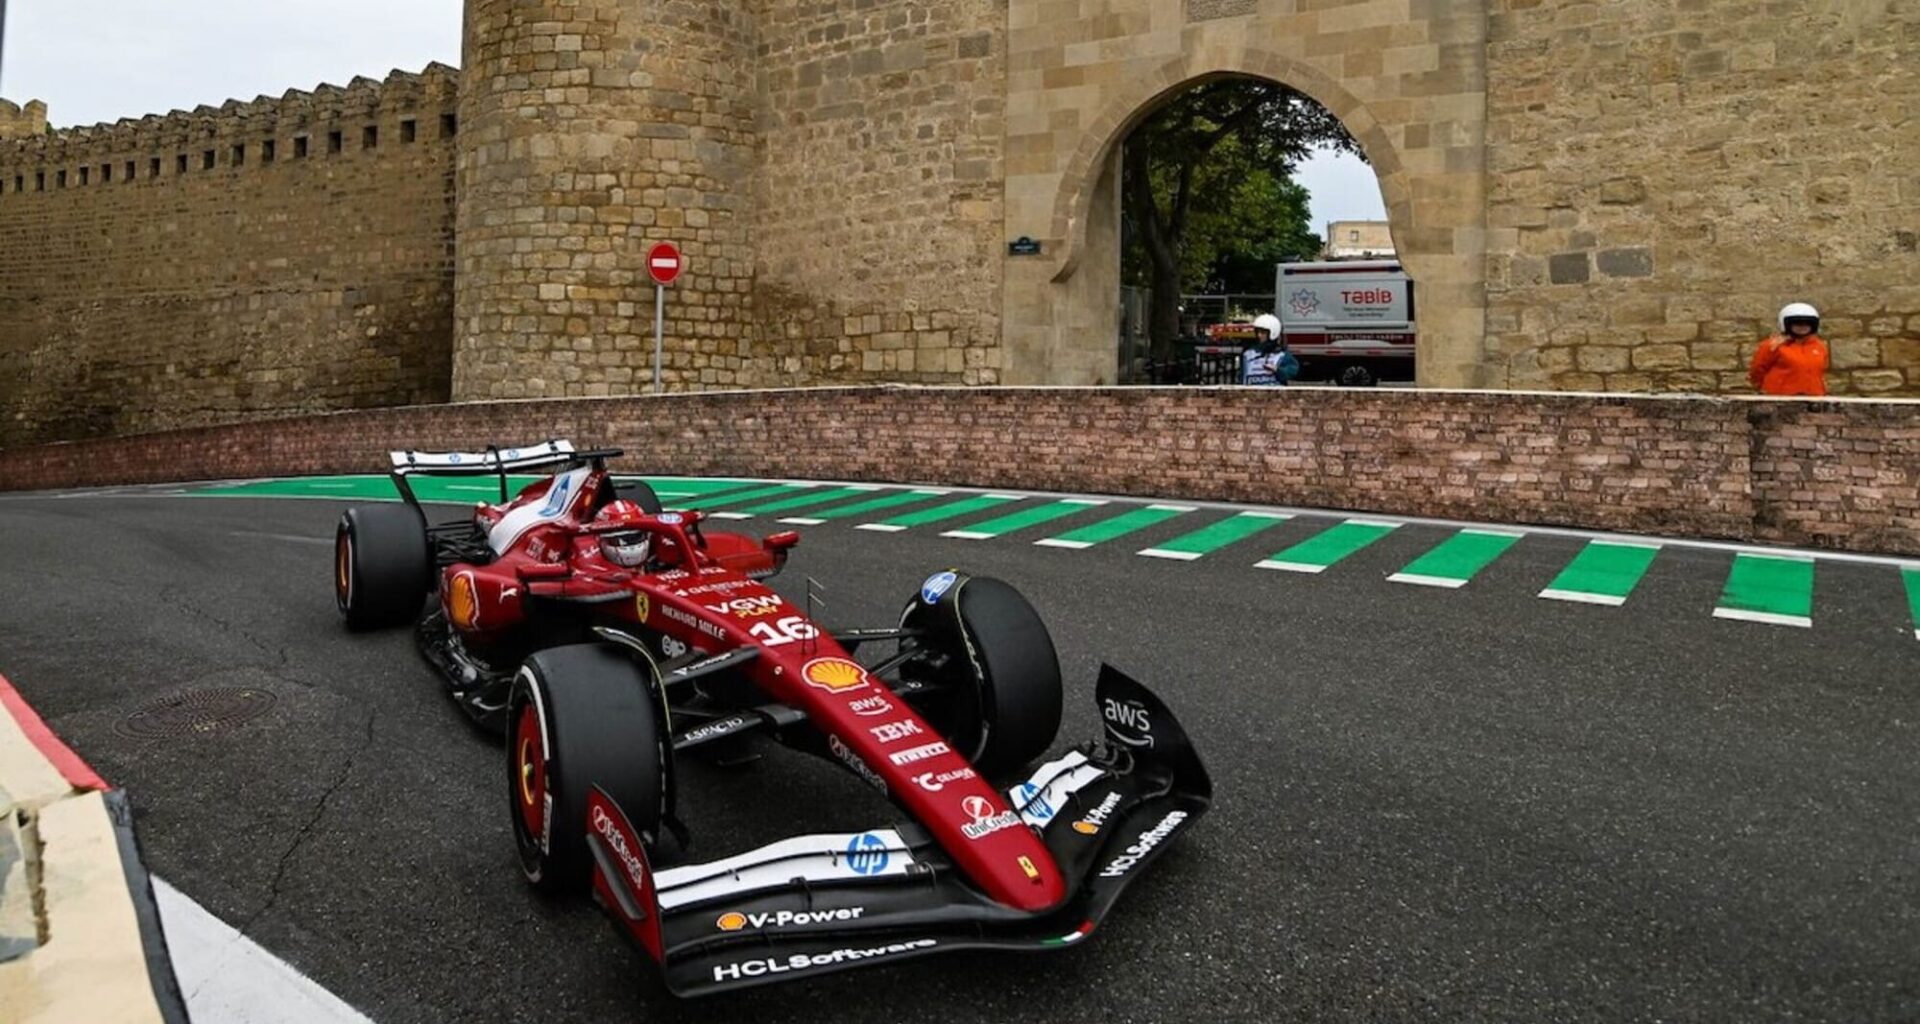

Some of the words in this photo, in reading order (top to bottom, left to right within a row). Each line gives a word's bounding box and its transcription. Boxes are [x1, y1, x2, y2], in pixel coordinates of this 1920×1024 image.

[704, 594, 783, 614] VGW
[661, 604, 697, 628] RICHARD
[698, 618, 727, 641] MILLE
[749, 616, 820, 646] 16
[849, 695, 887, 712] aws
[1105, 698, 1151, 732] aws
[684, 717, 744, 741] ESPACIO
[869, 719, 923, 743] IBM
[1083, 791, 1122, 826] V-Power
[961, 810, 1022, 839] UniCredit
[848, 834, 888, 874] hp
[1100, 810, 1188, 877] HCLSoftware
[748, 907, 863, 928] V-Power
[713, 938, 937, 981] HCLSoftware
